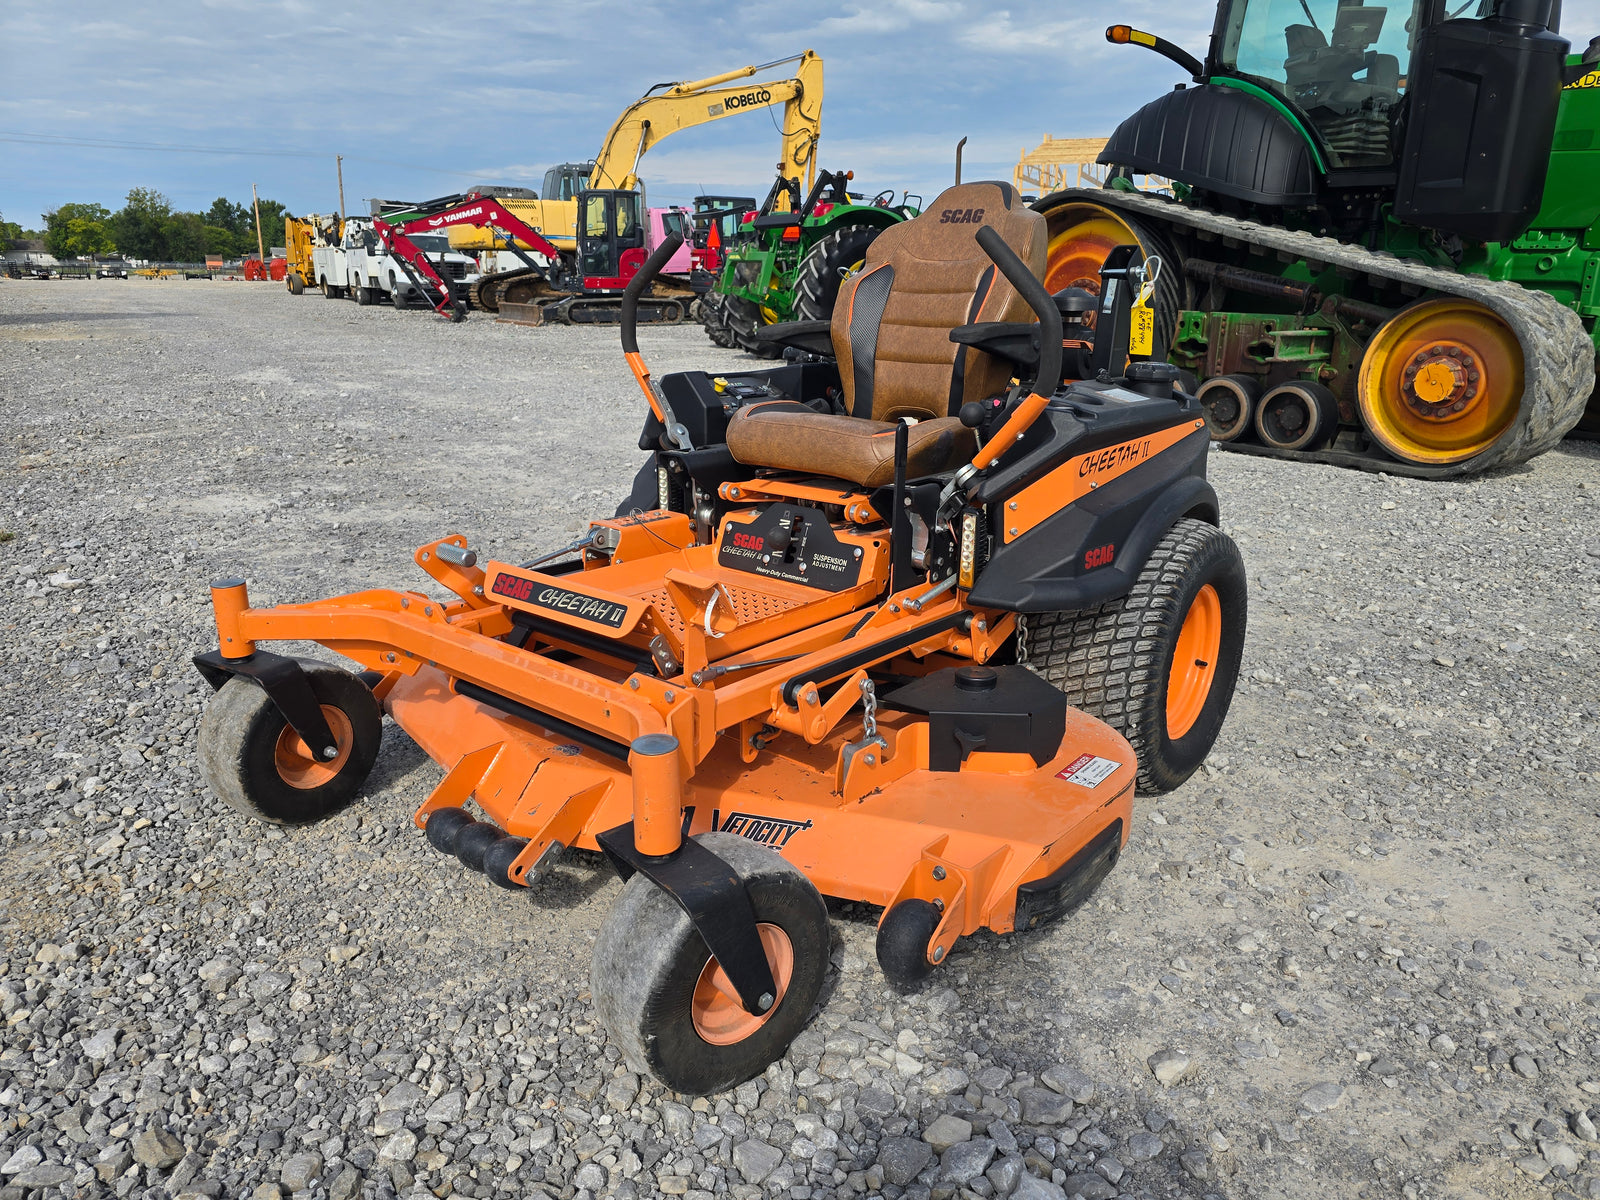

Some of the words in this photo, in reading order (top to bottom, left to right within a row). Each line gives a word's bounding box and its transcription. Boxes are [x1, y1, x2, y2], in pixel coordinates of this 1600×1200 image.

[724, 90, 771, 110] KOBELCO
[443, 207, 482, 223] YANMAR
[939, 208, 985, 224] SCAG
[1079, 441, 1142, 477] CHEETAH
[1142, 441, 1150, 458] II
[733, 532, 764, 551] SCAG
[722, 545, 757, 560] CHEETAH
[812, 553, 848, 567] SUSPENSION
[1084, 544, 1115, 570] SCAG
[755, 565, 782, 578] Heavy-Duty
[781, 571, 809, 583] Commercial
[811, 561, 846, 573] ADJUSTMENT
[493, 573, 534, 600] SCAG
[538, 588, 613, 620] CHEETAH
[610, 608, 624, 622] II
